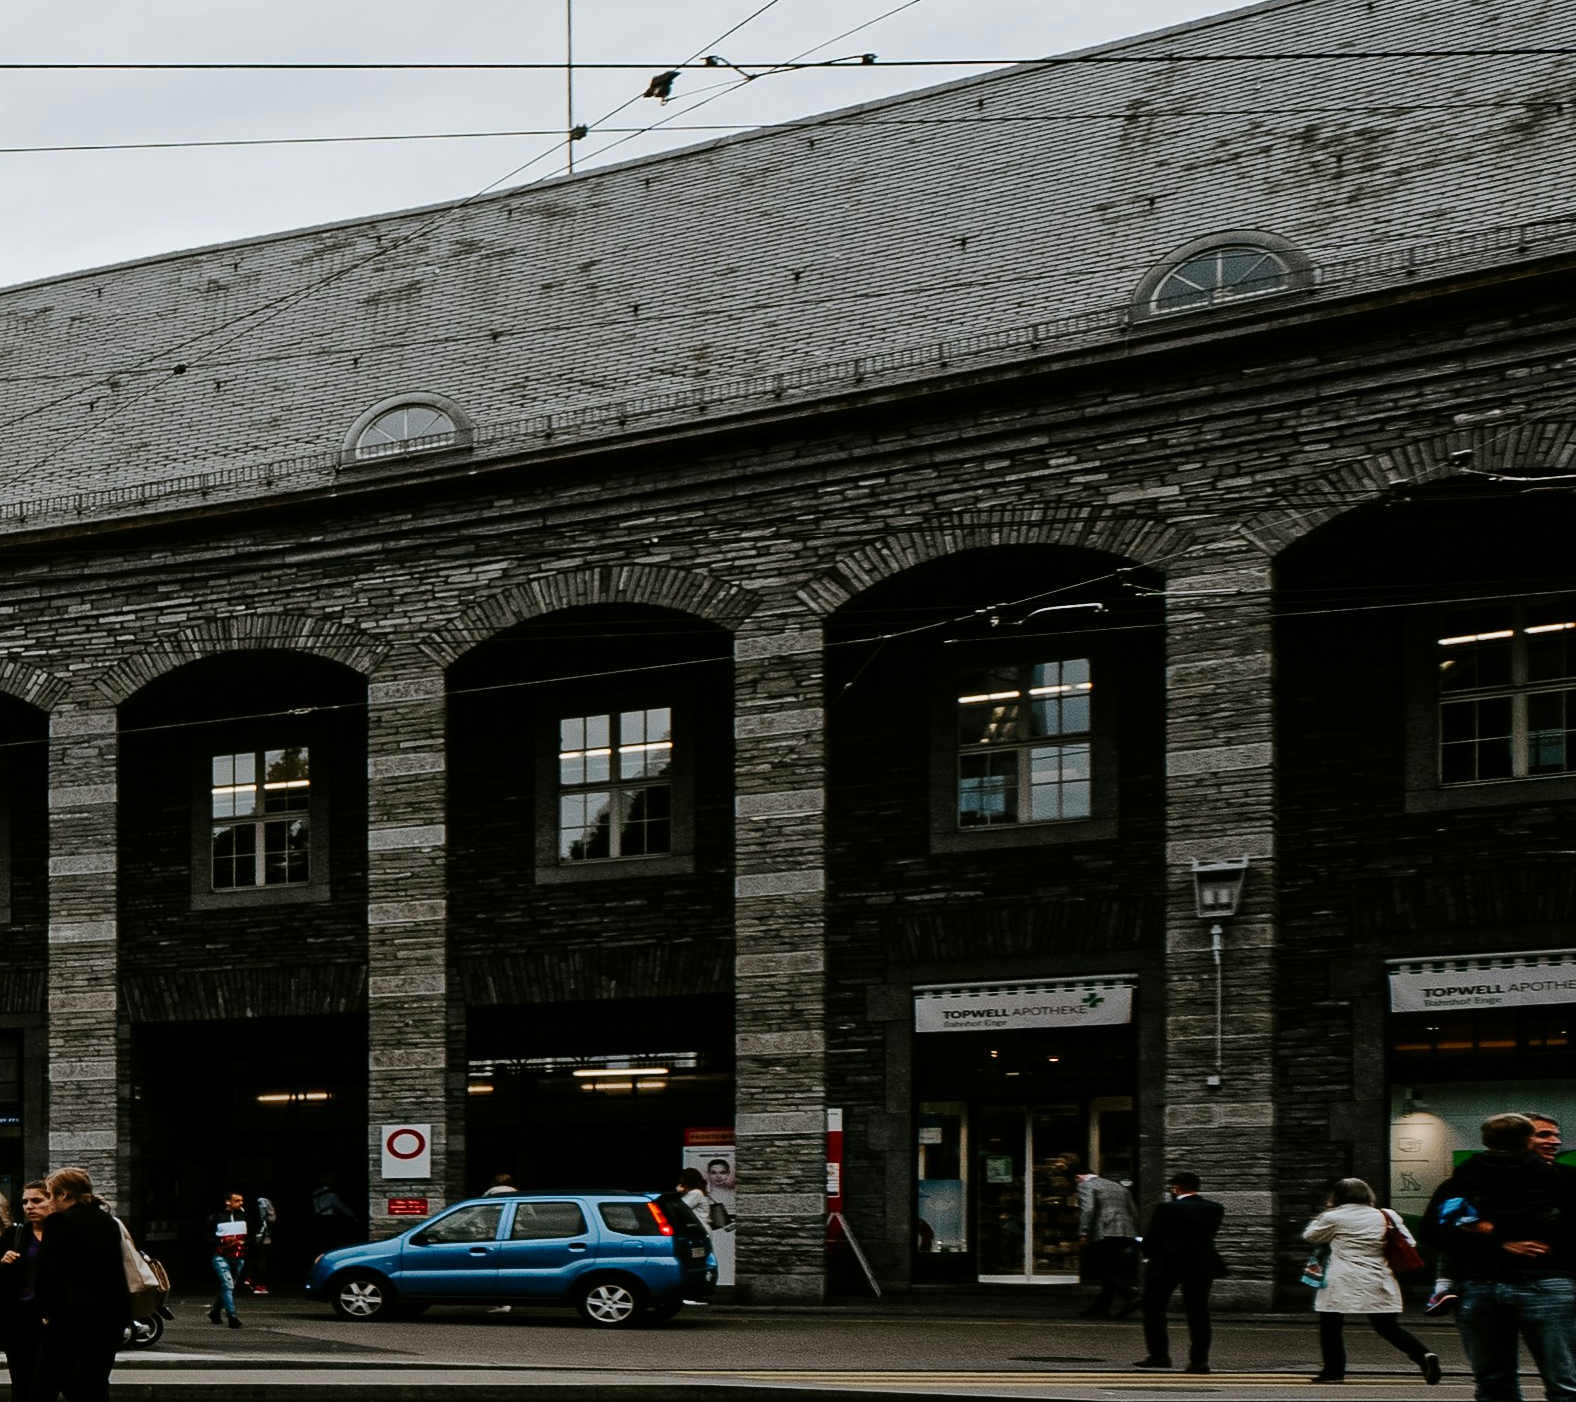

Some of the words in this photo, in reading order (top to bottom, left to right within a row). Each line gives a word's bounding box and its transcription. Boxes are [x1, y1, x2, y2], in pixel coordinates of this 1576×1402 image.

[1422, 984, 1505, 998] TOPWELL
[942, 1008, 1010, 1020] TOPWELL
[1011, 1004, 1088, 1017] APOTHEKE
